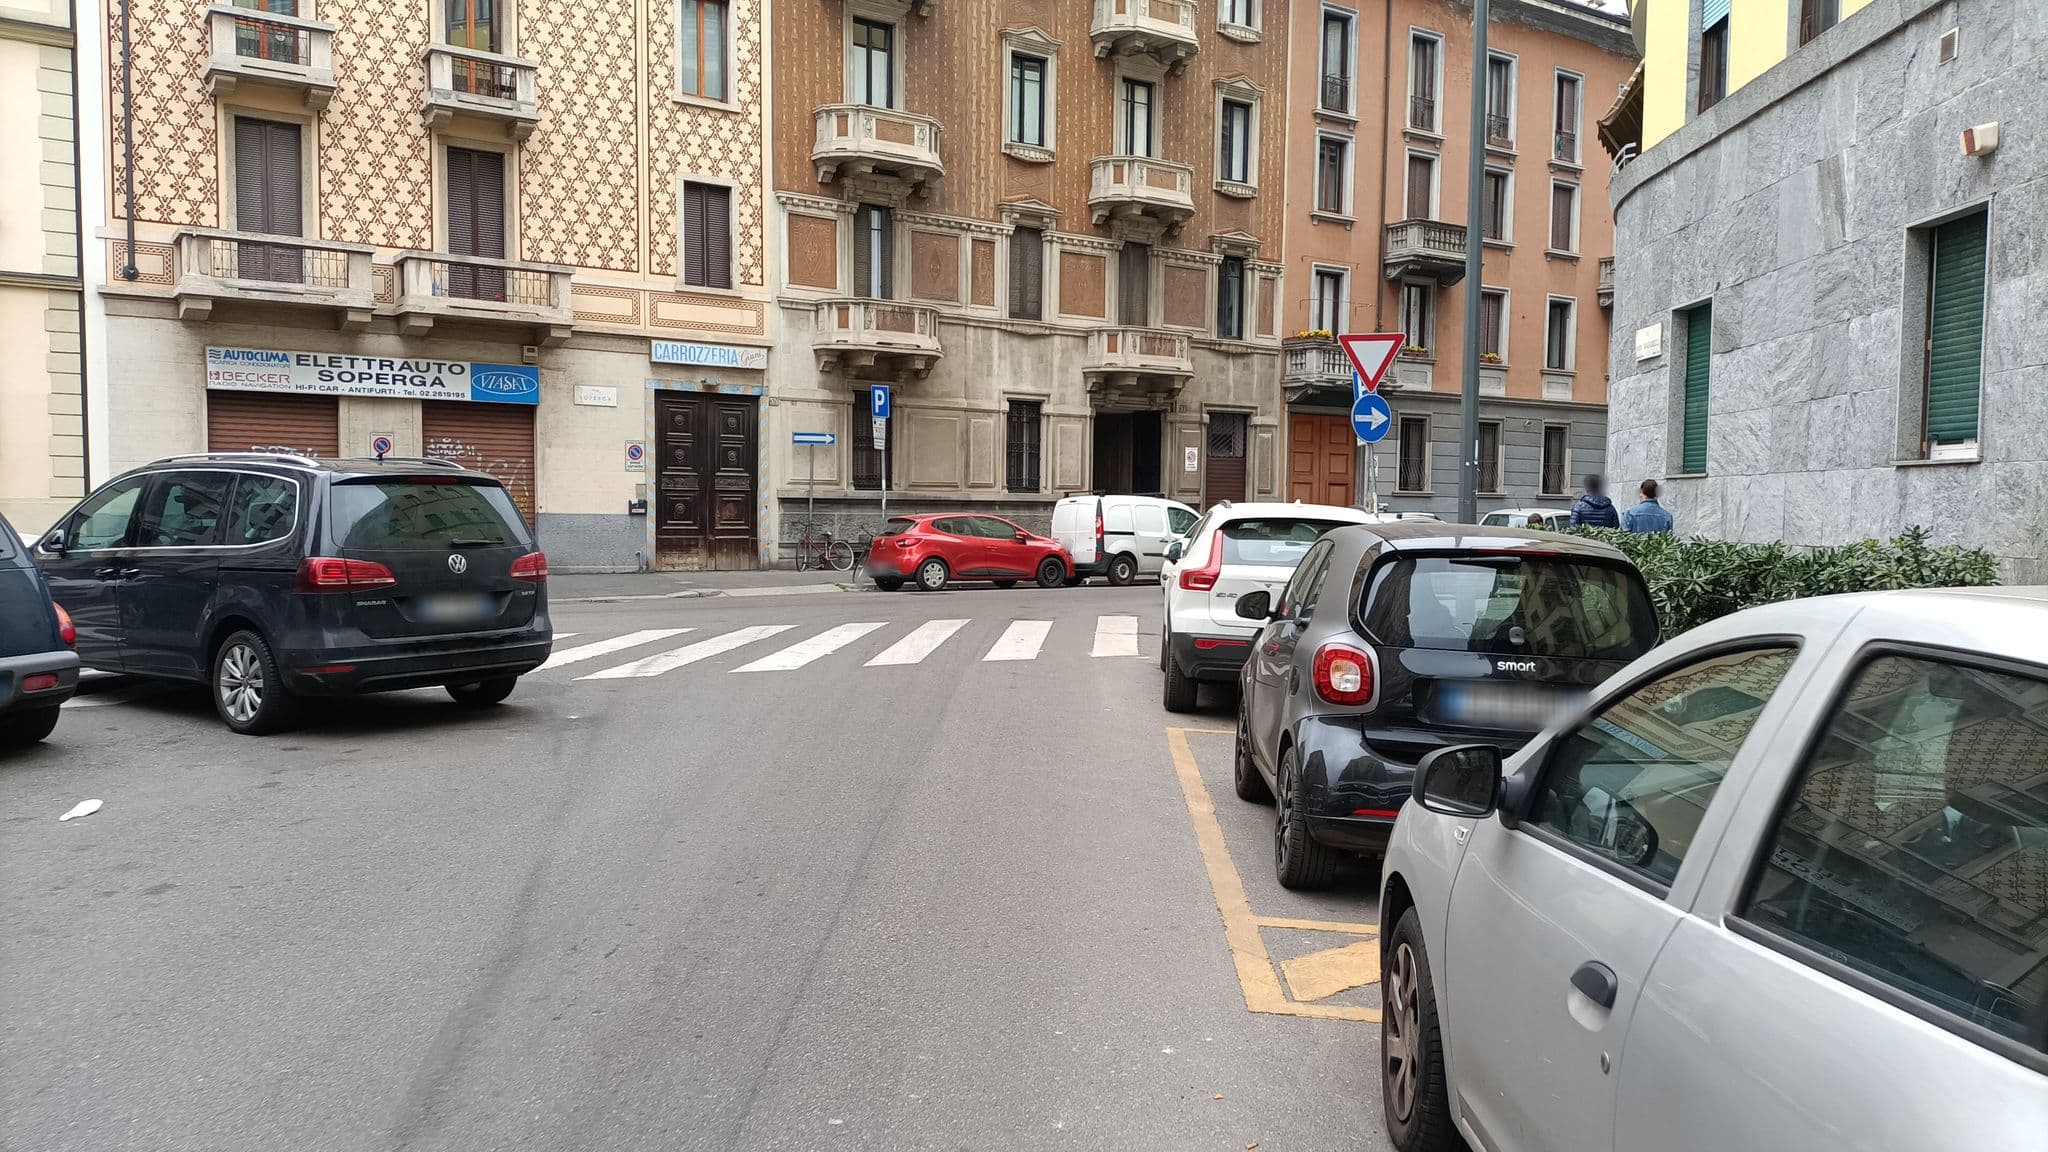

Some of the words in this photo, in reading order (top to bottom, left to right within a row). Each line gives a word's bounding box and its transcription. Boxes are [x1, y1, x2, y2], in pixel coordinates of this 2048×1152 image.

[223, 349, 290, 363] AUTOCLIMA
[654, 343, 738, 366] CARROZZERIA
[295, 353, 466, 376] ELETTRAUTO
[222, 371, 291, 384] BECKER
[317, 369, 446, 389] SOPERGA
[480, 375, 530, 391] VIASAT
[347, 386, 396, 395] ANTIFURTI
[402, 389, 417, 397] Tel.
[419, 390, 466, 399] 02.2619195
[874, 389, 885, 413] P
[1496, 661, 1537, 672] smart
